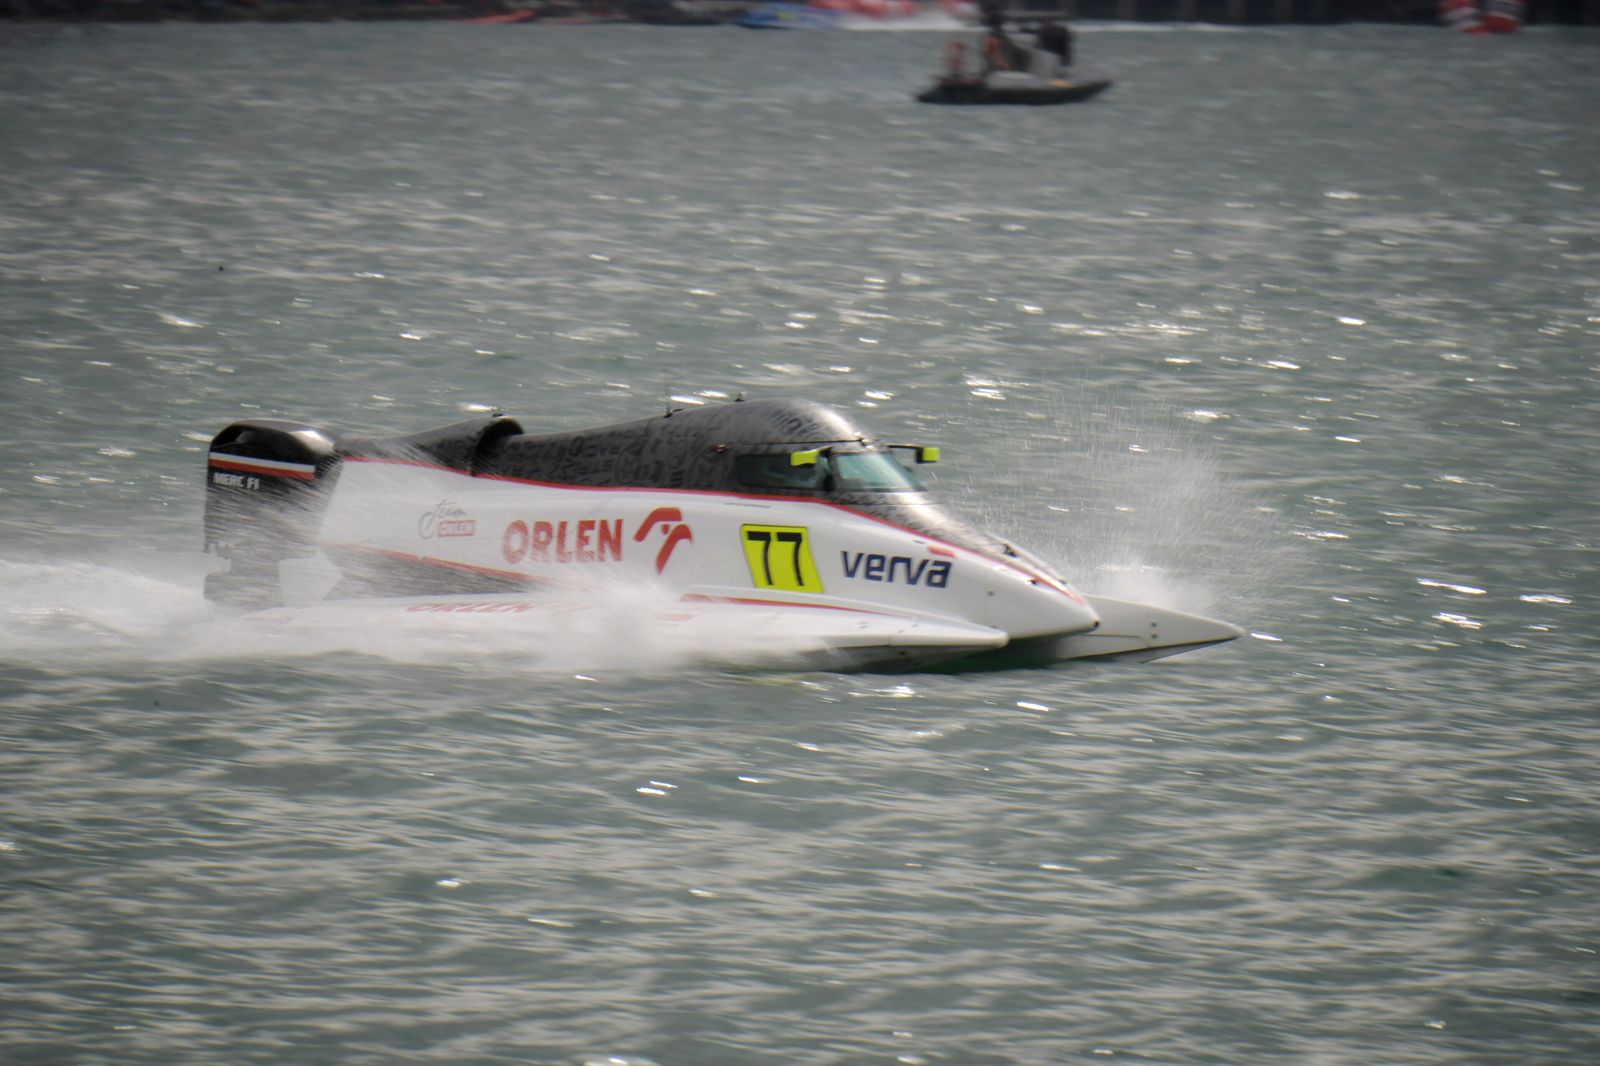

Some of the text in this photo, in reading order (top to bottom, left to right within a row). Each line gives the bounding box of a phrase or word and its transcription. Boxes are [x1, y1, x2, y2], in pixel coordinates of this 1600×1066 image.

[501, 519, 624, 564] ORLEN
[747, 531, 804, 586] 77
[841, 551, 952, 588] verva
